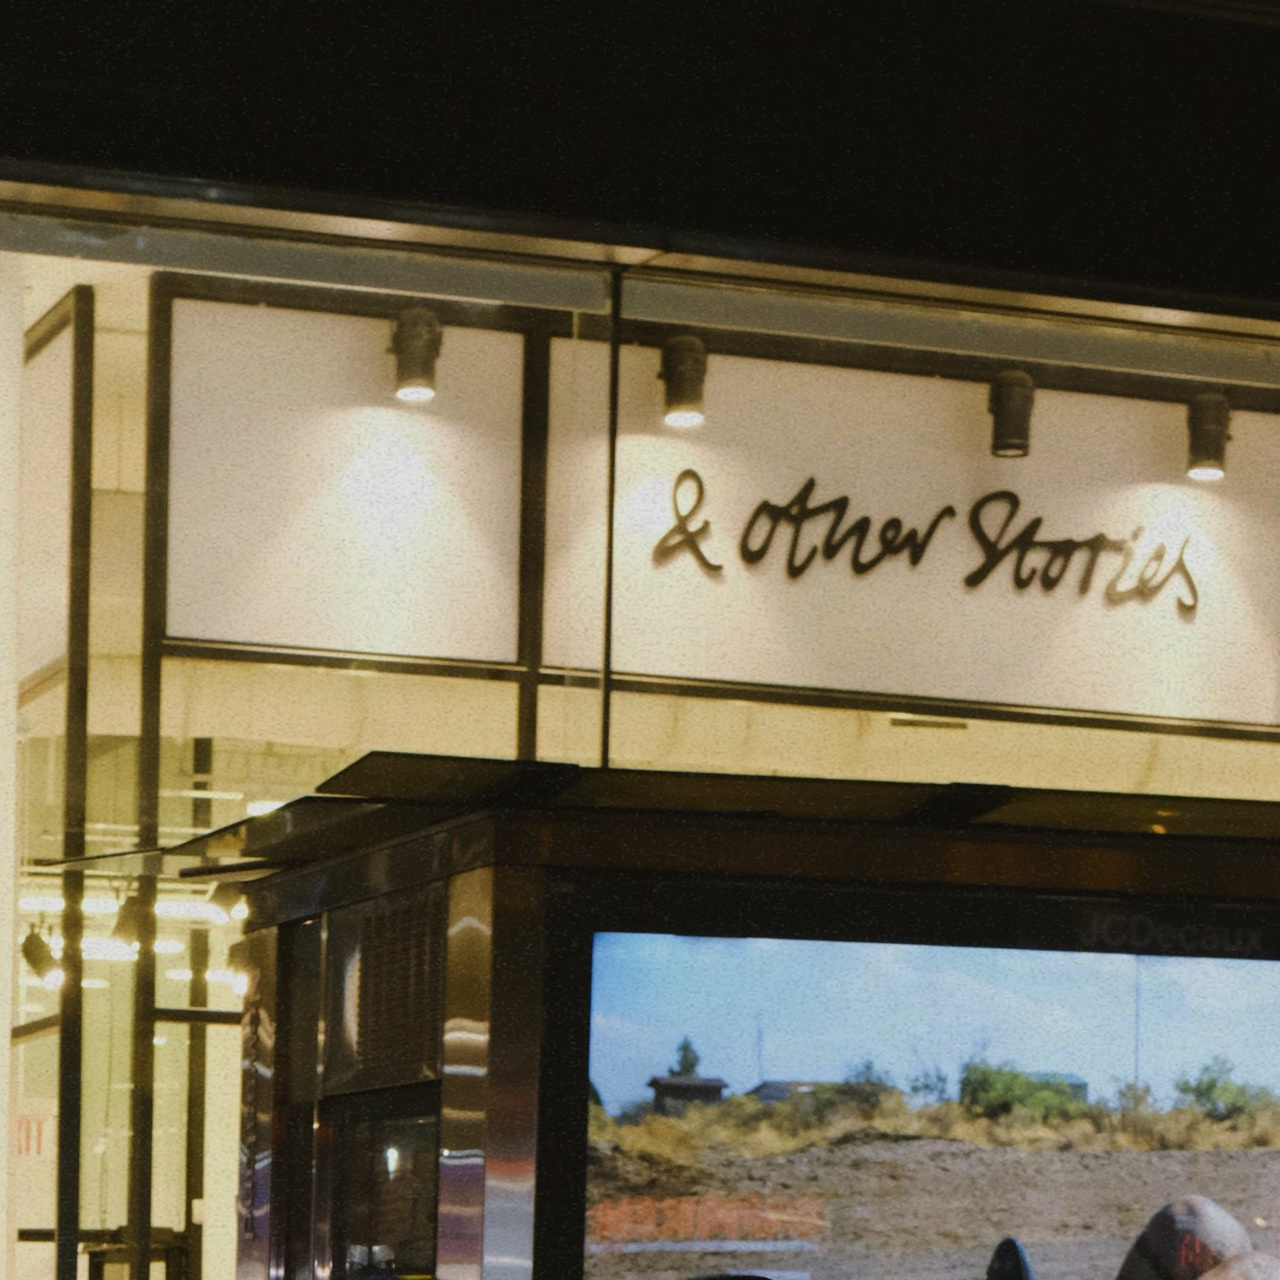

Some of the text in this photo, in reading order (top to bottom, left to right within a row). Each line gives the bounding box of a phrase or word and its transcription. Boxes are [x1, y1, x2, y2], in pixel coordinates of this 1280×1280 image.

[653, 468, 1199, 622] & other Stories
